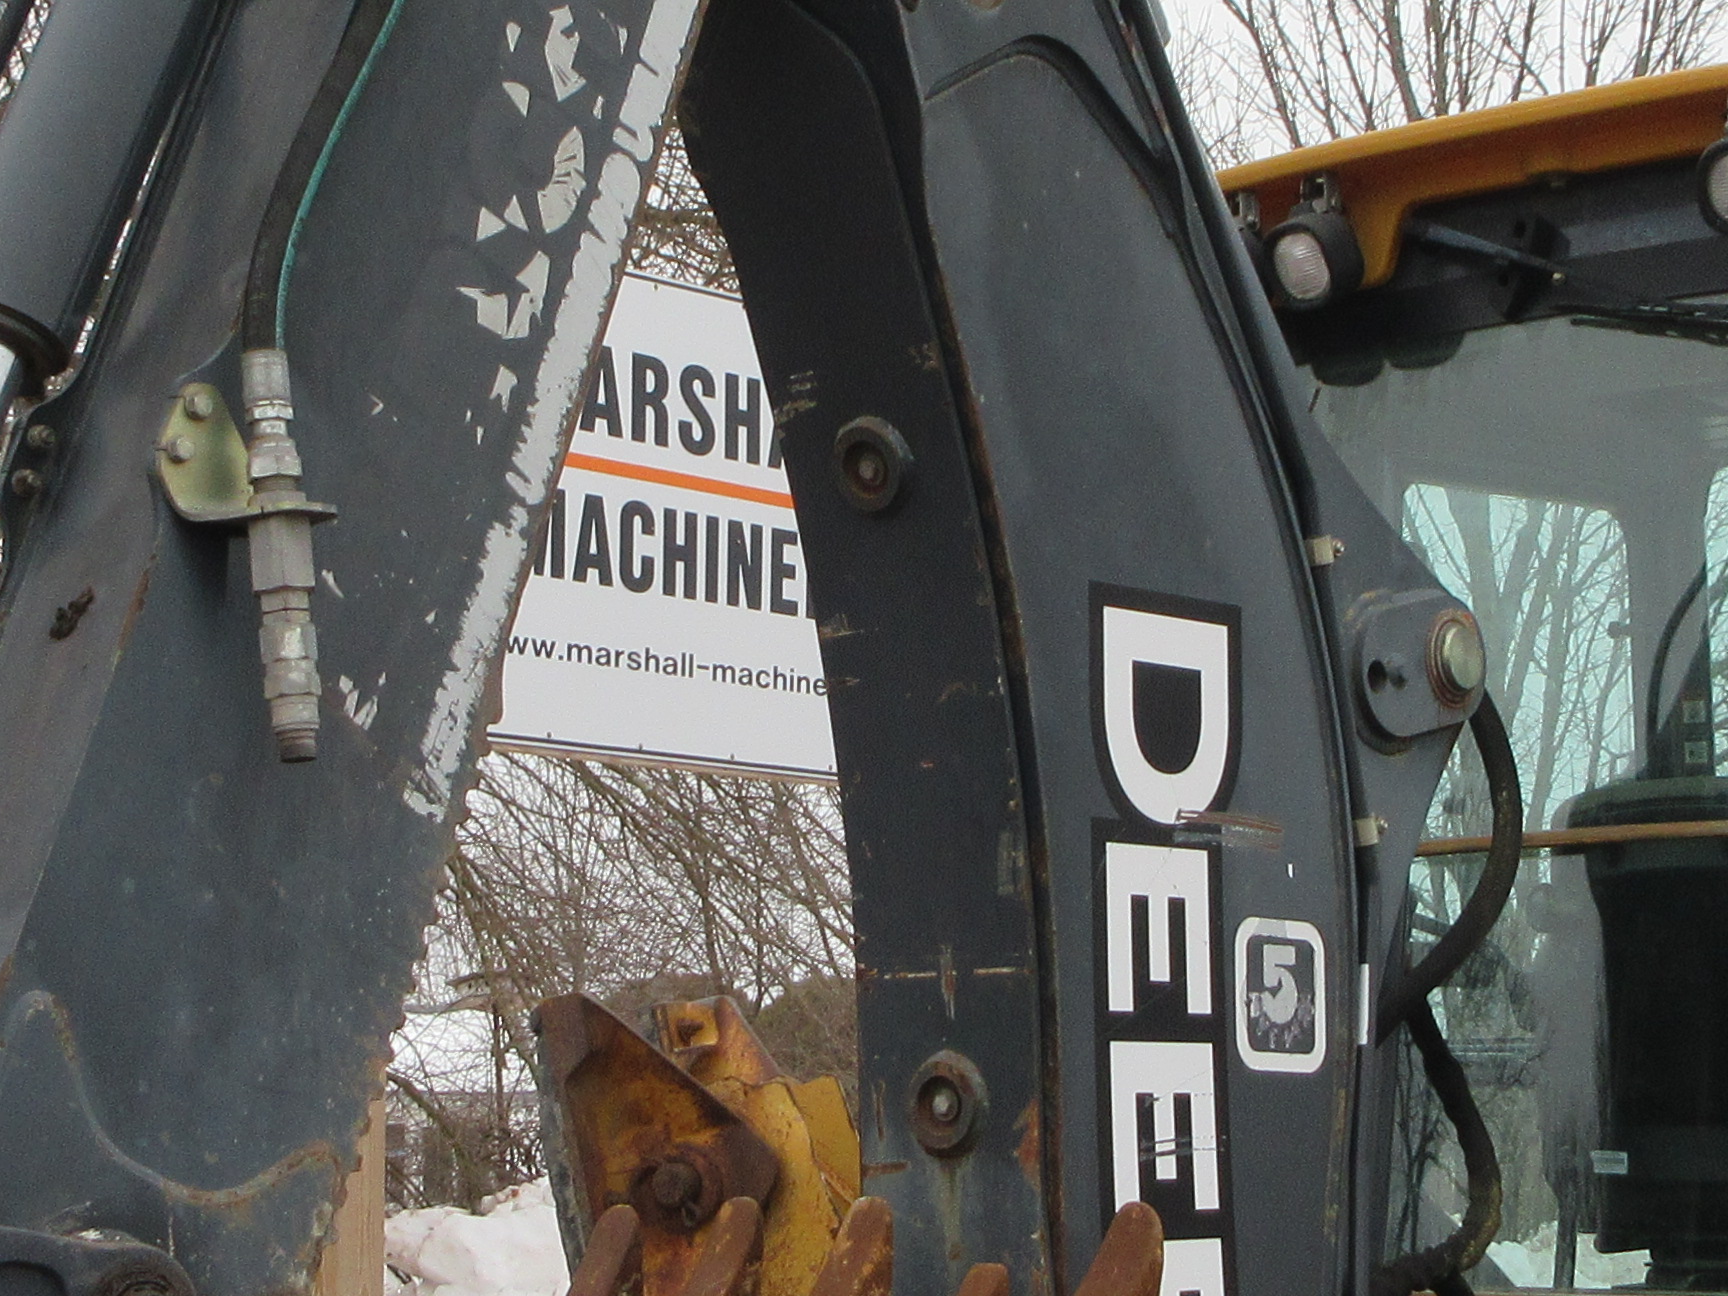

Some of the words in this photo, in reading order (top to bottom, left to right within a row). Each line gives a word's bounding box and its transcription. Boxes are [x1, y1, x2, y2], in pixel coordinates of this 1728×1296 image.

[580, 345, 784, 471] ARSH
[534, 488, 815, 620] MACHINE
[1263, 943, 1298, 1025] 5
